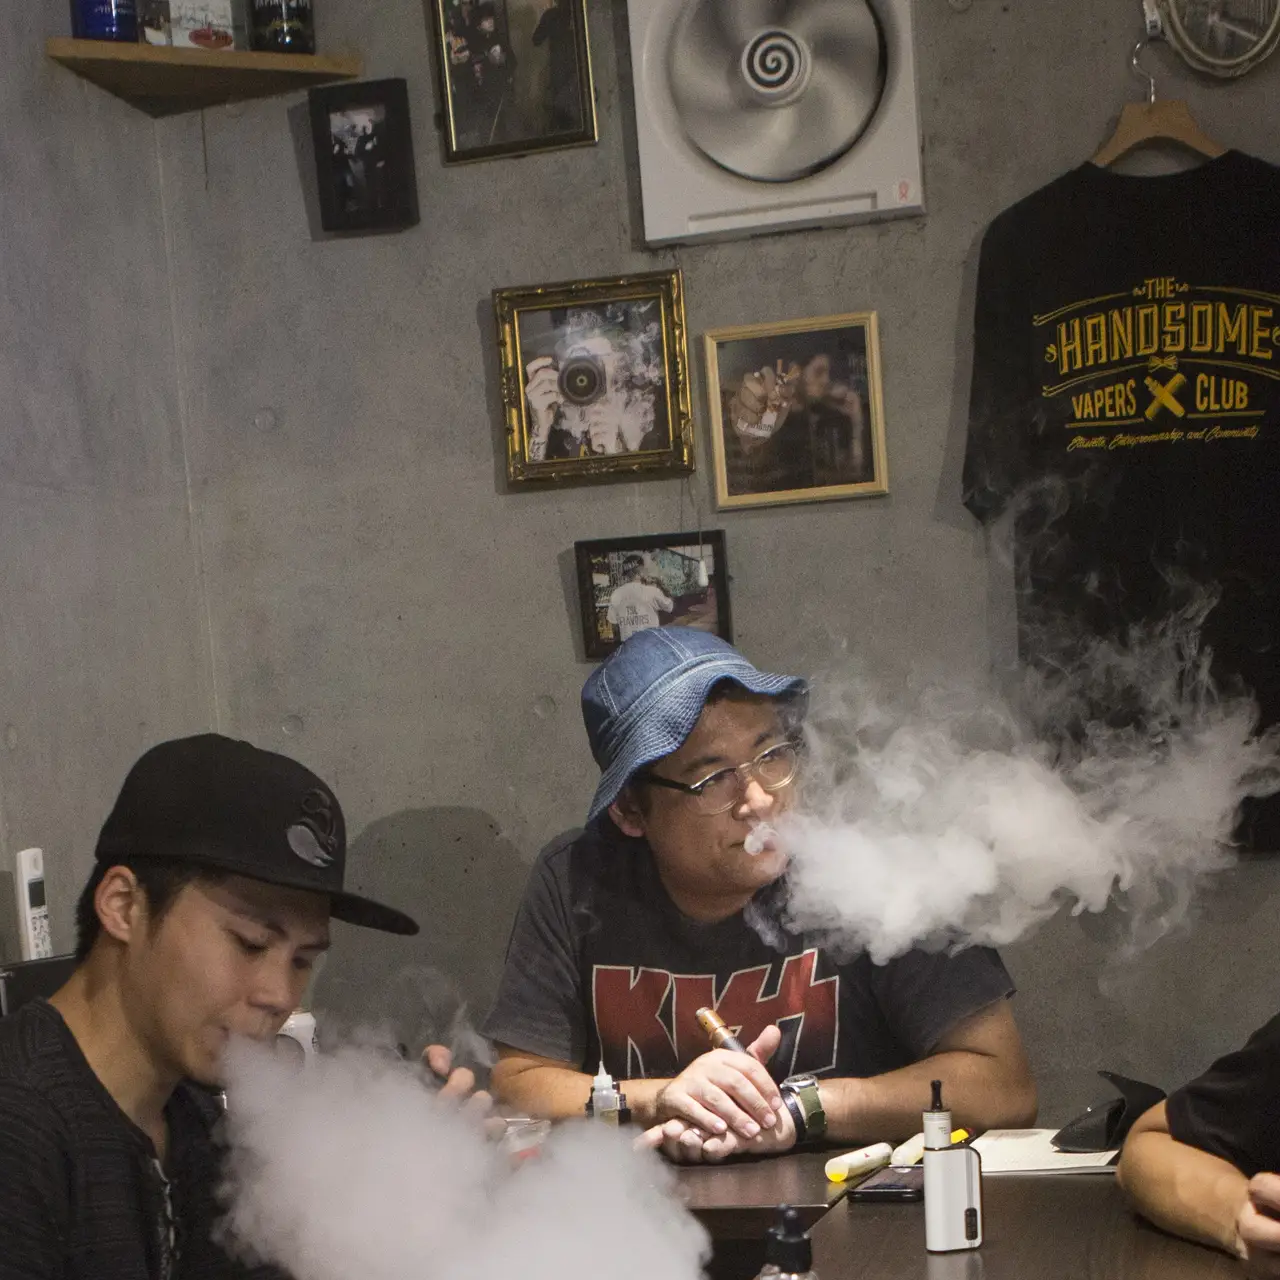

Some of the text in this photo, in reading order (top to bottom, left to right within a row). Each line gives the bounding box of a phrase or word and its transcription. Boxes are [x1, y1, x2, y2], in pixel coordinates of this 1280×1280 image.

[1145, 276, 1176, 299] THE
[1057, 302, 1274, 374] HANDSOME
[1072, 373, 1249, 418] VAPERS CLUB
[1186, 427, 1209, 440] and
